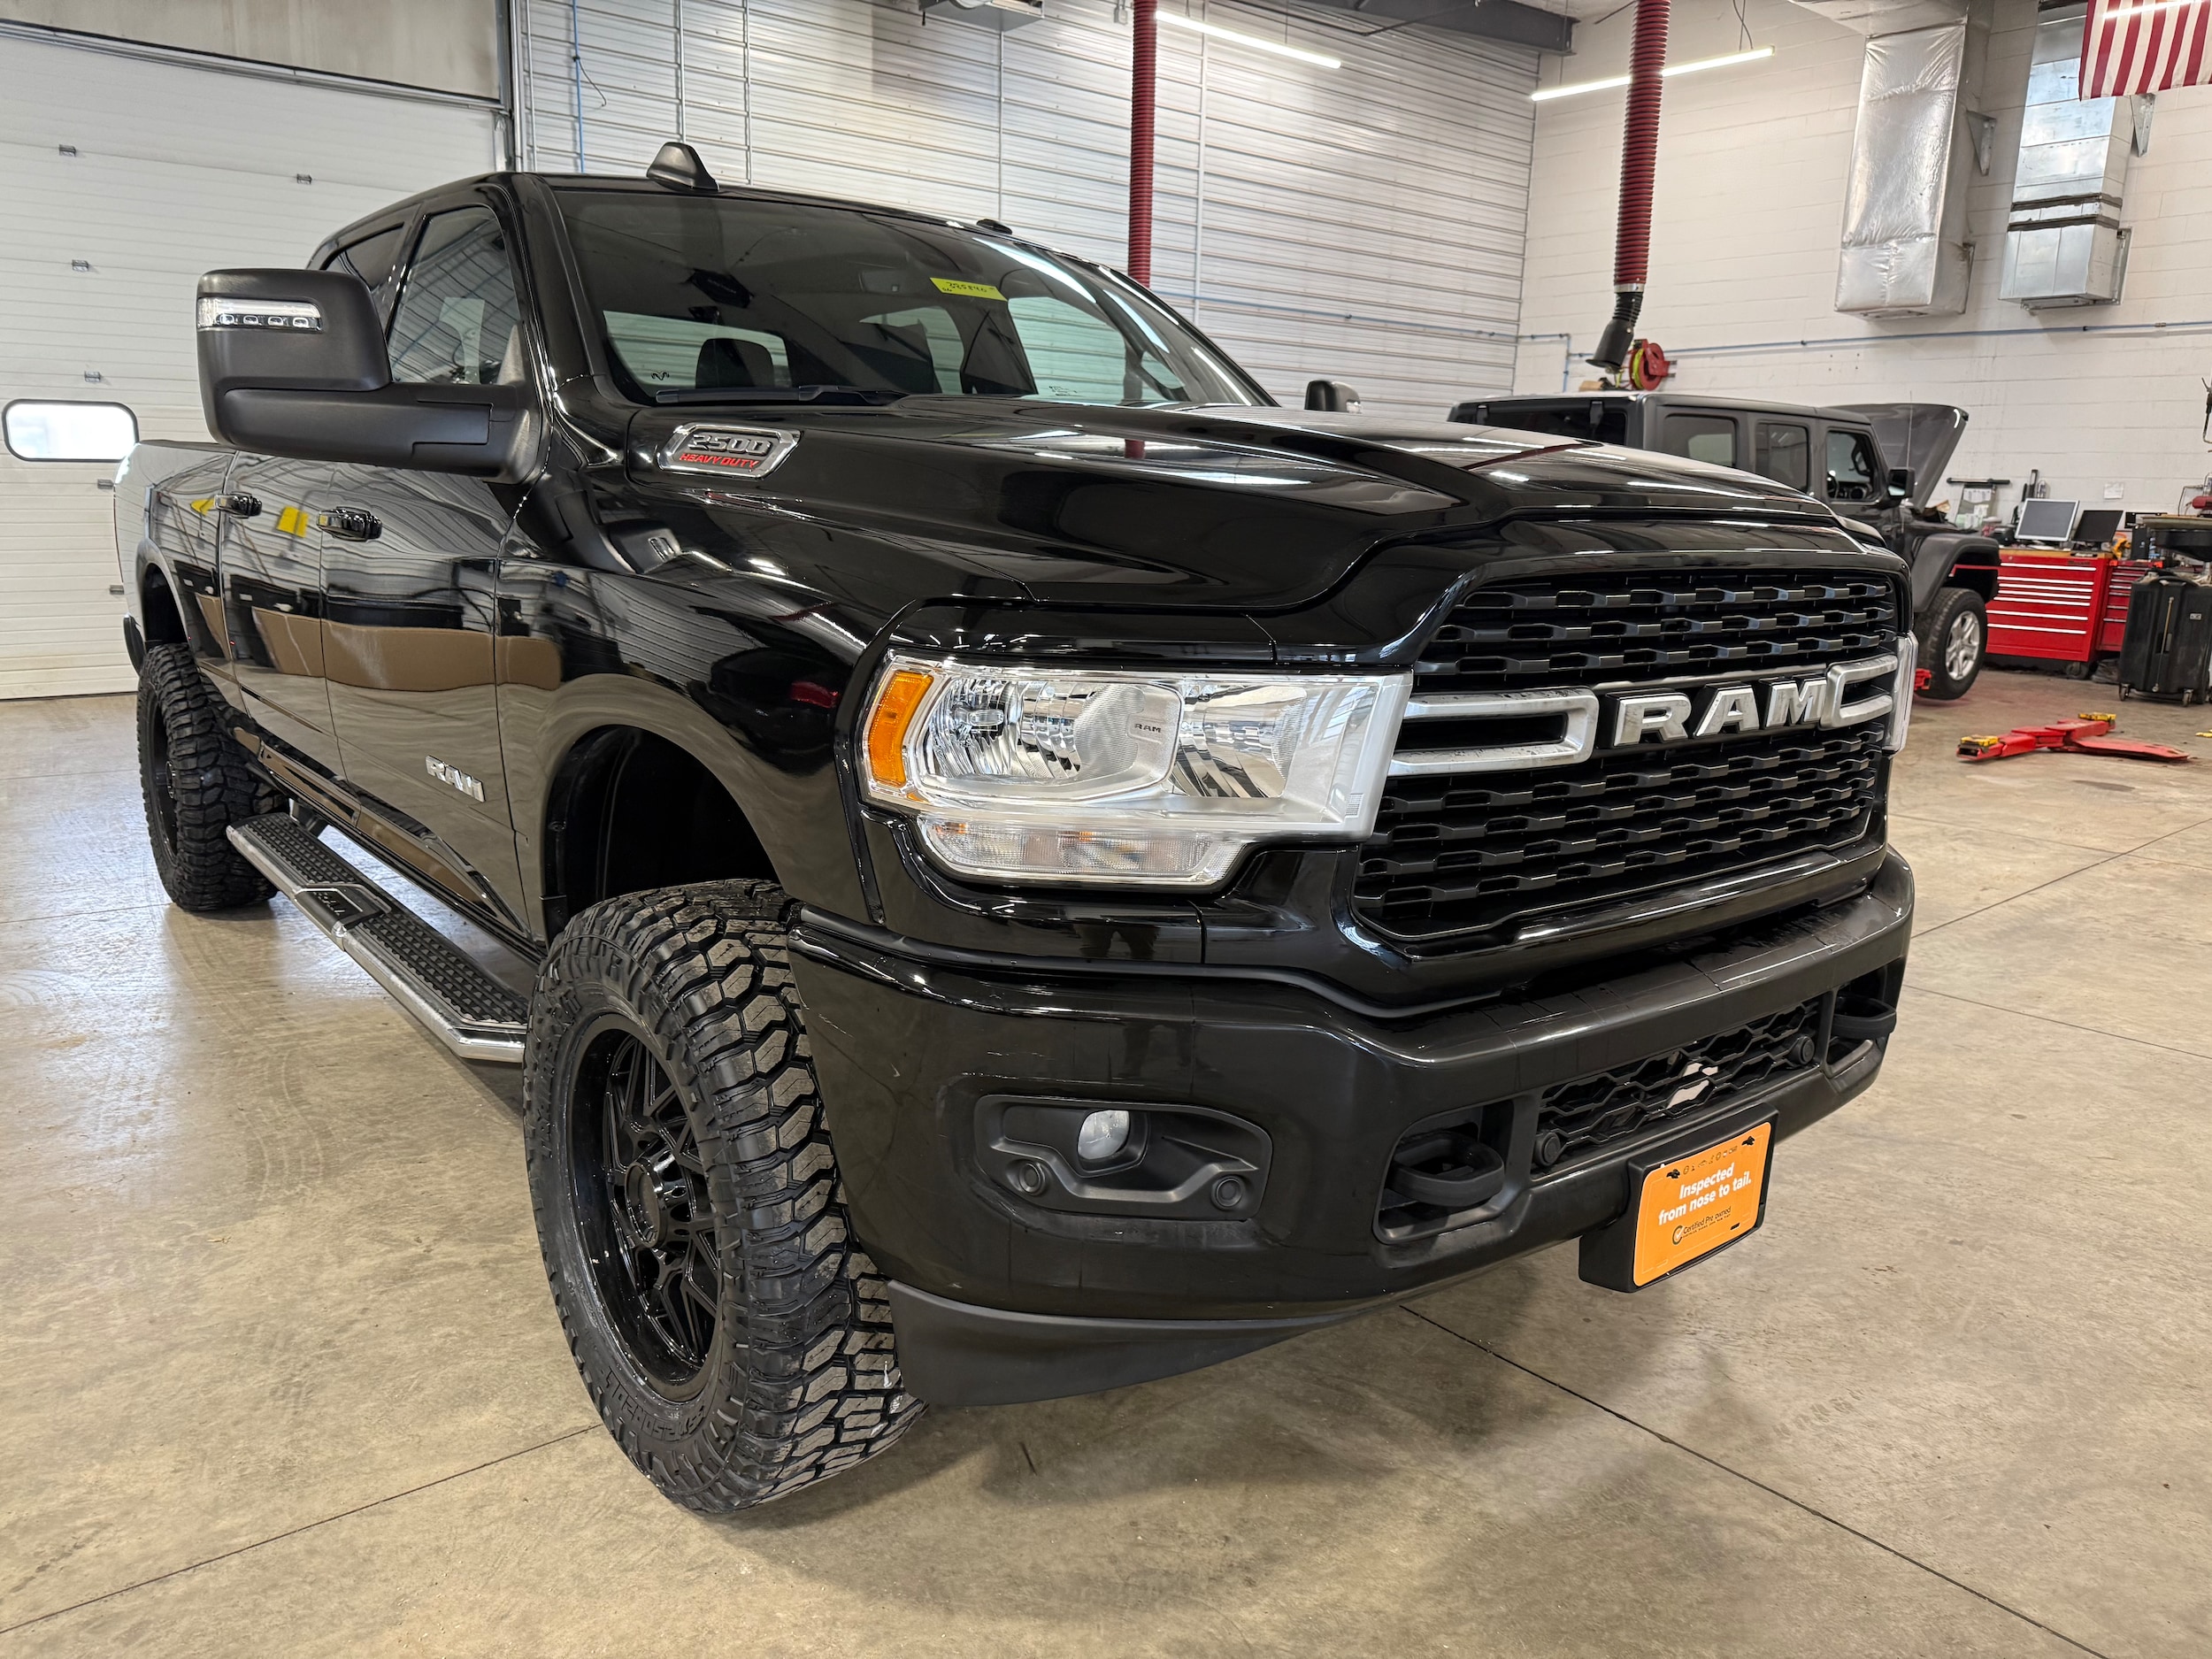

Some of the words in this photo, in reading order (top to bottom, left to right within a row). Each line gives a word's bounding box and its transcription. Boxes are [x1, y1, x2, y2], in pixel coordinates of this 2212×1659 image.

[688, 434, 772, 456] 2500
[679, 452, 722, 465] HEAVY
[721, 457, 760, 468] DUTY
[1608, 676, 1828, 748] RAM
[1133, 723, 1161, 733] RAM
[426, 755, 486, 803] RAM
[1679, 1163, 1735, 1200] Inspected
[1658, 1203, 1687, 1226] from
[1689, 1192, 1716, 1210] nose
[1718, 1184, 1730, 1198] to
[1732, 1171, 1752, 1192] tail.
[1683, 1217, 1705, 1234] Certified
